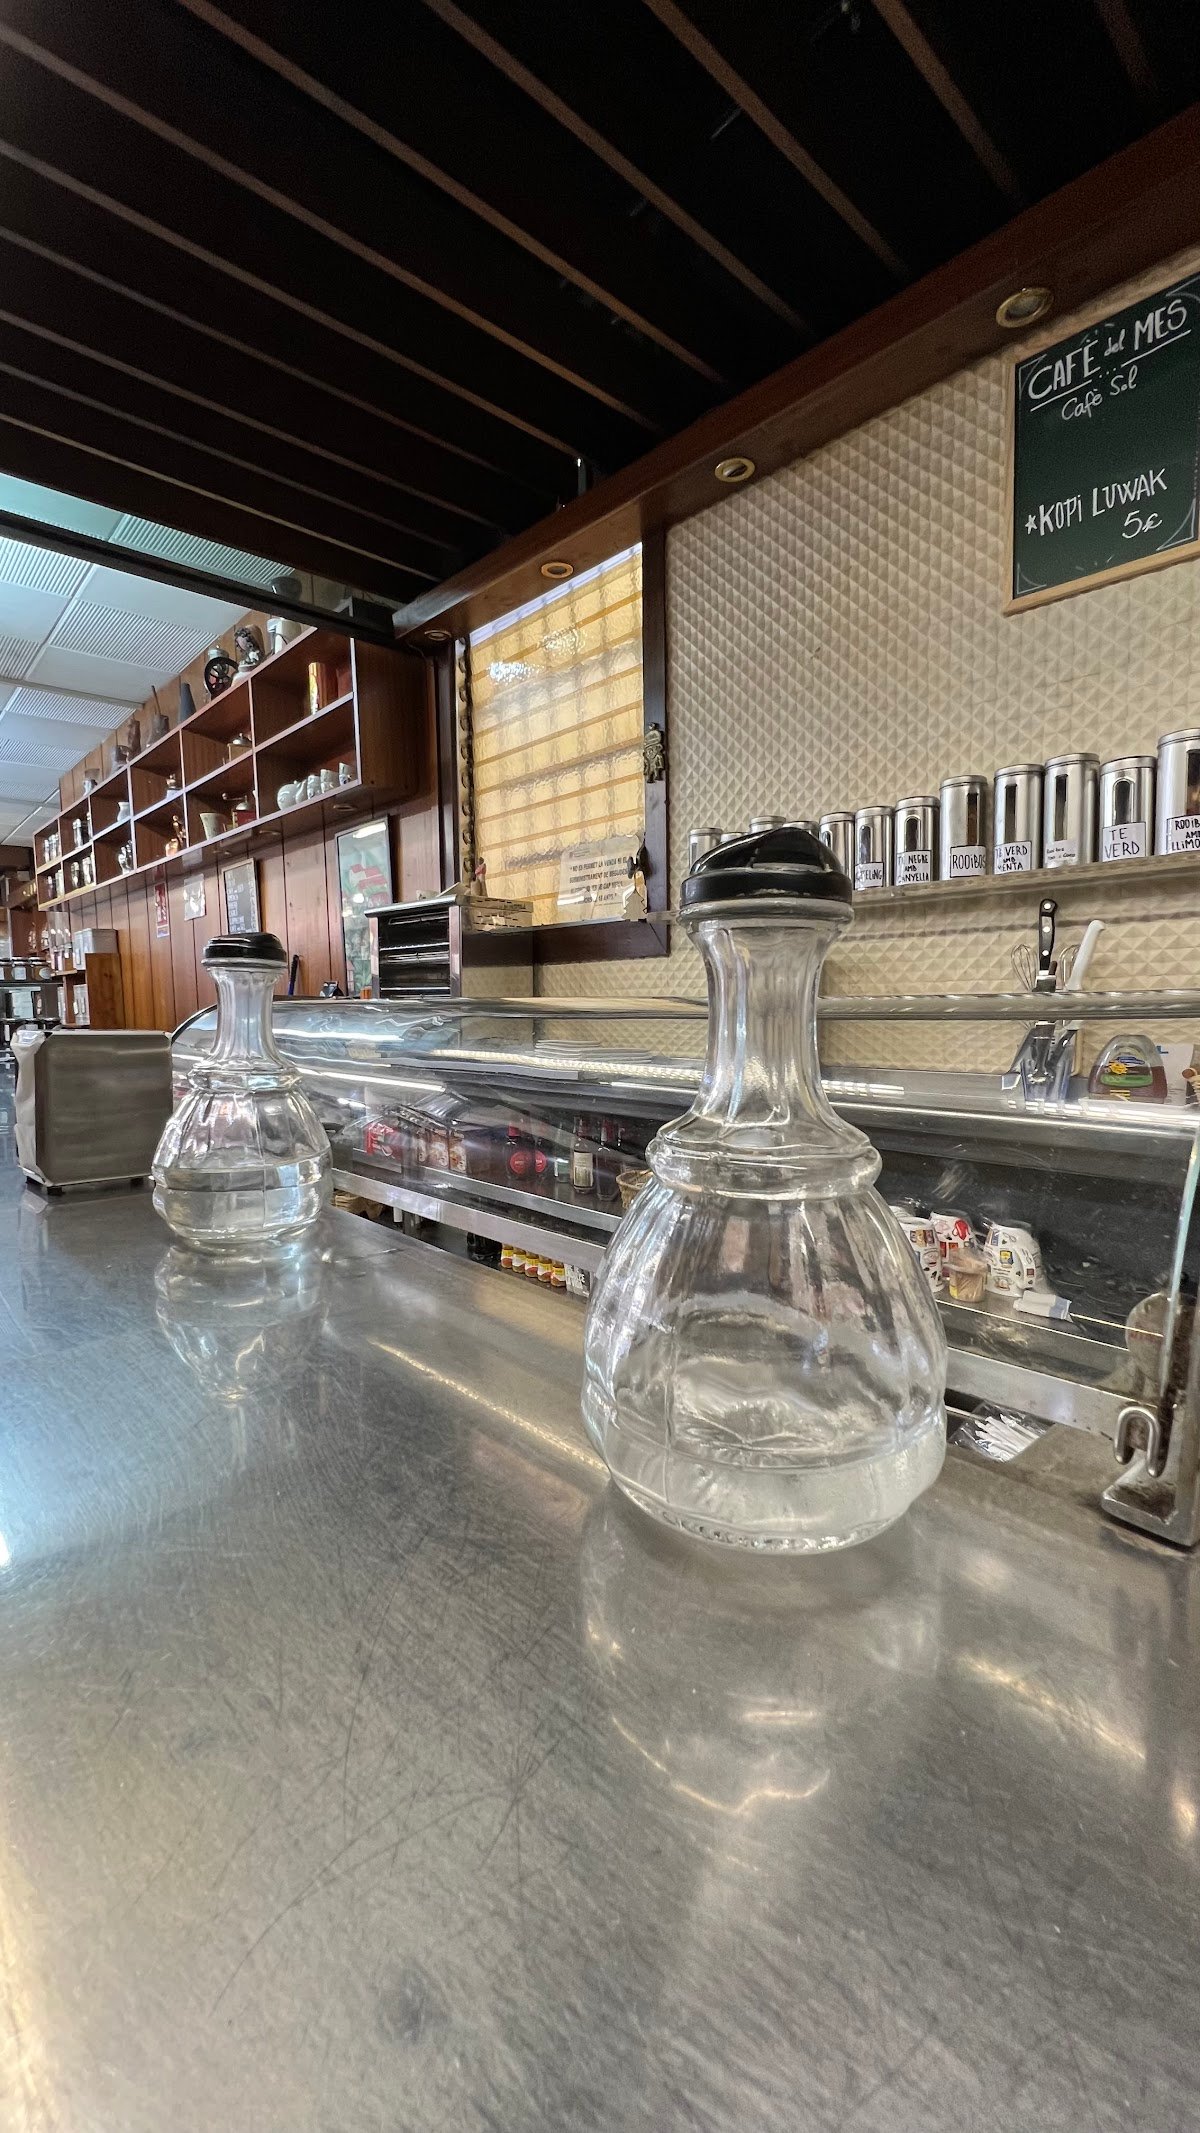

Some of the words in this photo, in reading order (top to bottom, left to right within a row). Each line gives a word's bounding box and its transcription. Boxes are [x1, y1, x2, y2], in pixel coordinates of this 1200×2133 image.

[1104, 328, 1126, 356] del
[1134, 299, 1187, 350] MES
[1110, 365, 1138, 396] Sol
[1092, 468, 1168, 517] LUWAK
[1122, 510, 1163, 539] 5€
[1109, 828, 1128, 841] TE
[908, 854, 929, 864] NEGRE
[1004, 845, 1028, 856] VERD
[1105, 841, 1140, 859] VERD
